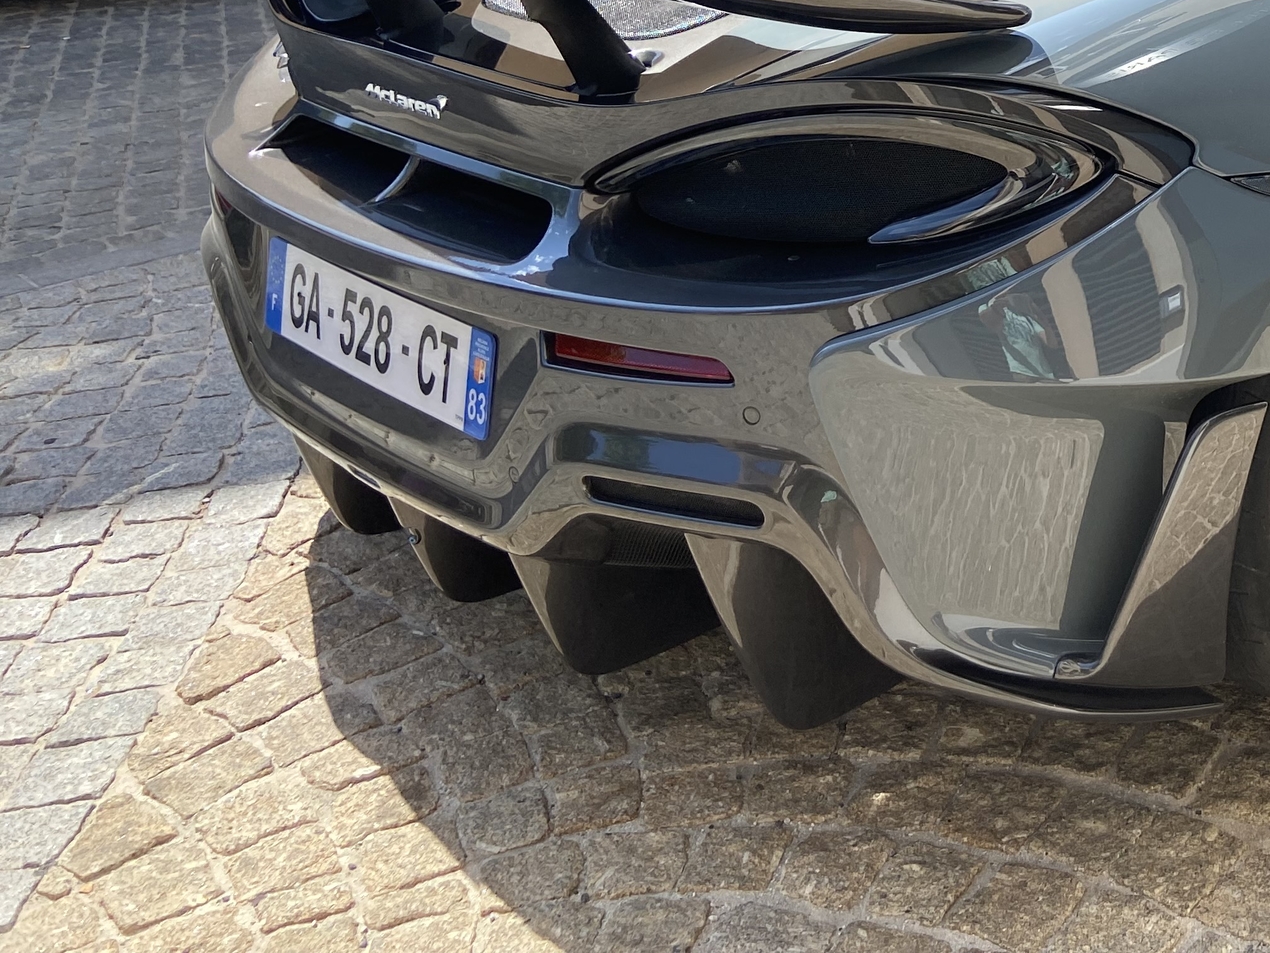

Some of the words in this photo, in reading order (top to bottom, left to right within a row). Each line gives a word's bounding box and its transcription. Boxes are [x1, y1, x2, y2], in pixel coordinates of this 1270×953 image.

[364, 82, 441, 120] McLaren
[271, 293, 278, 311] F
[467, 388, 486, 425] 83
